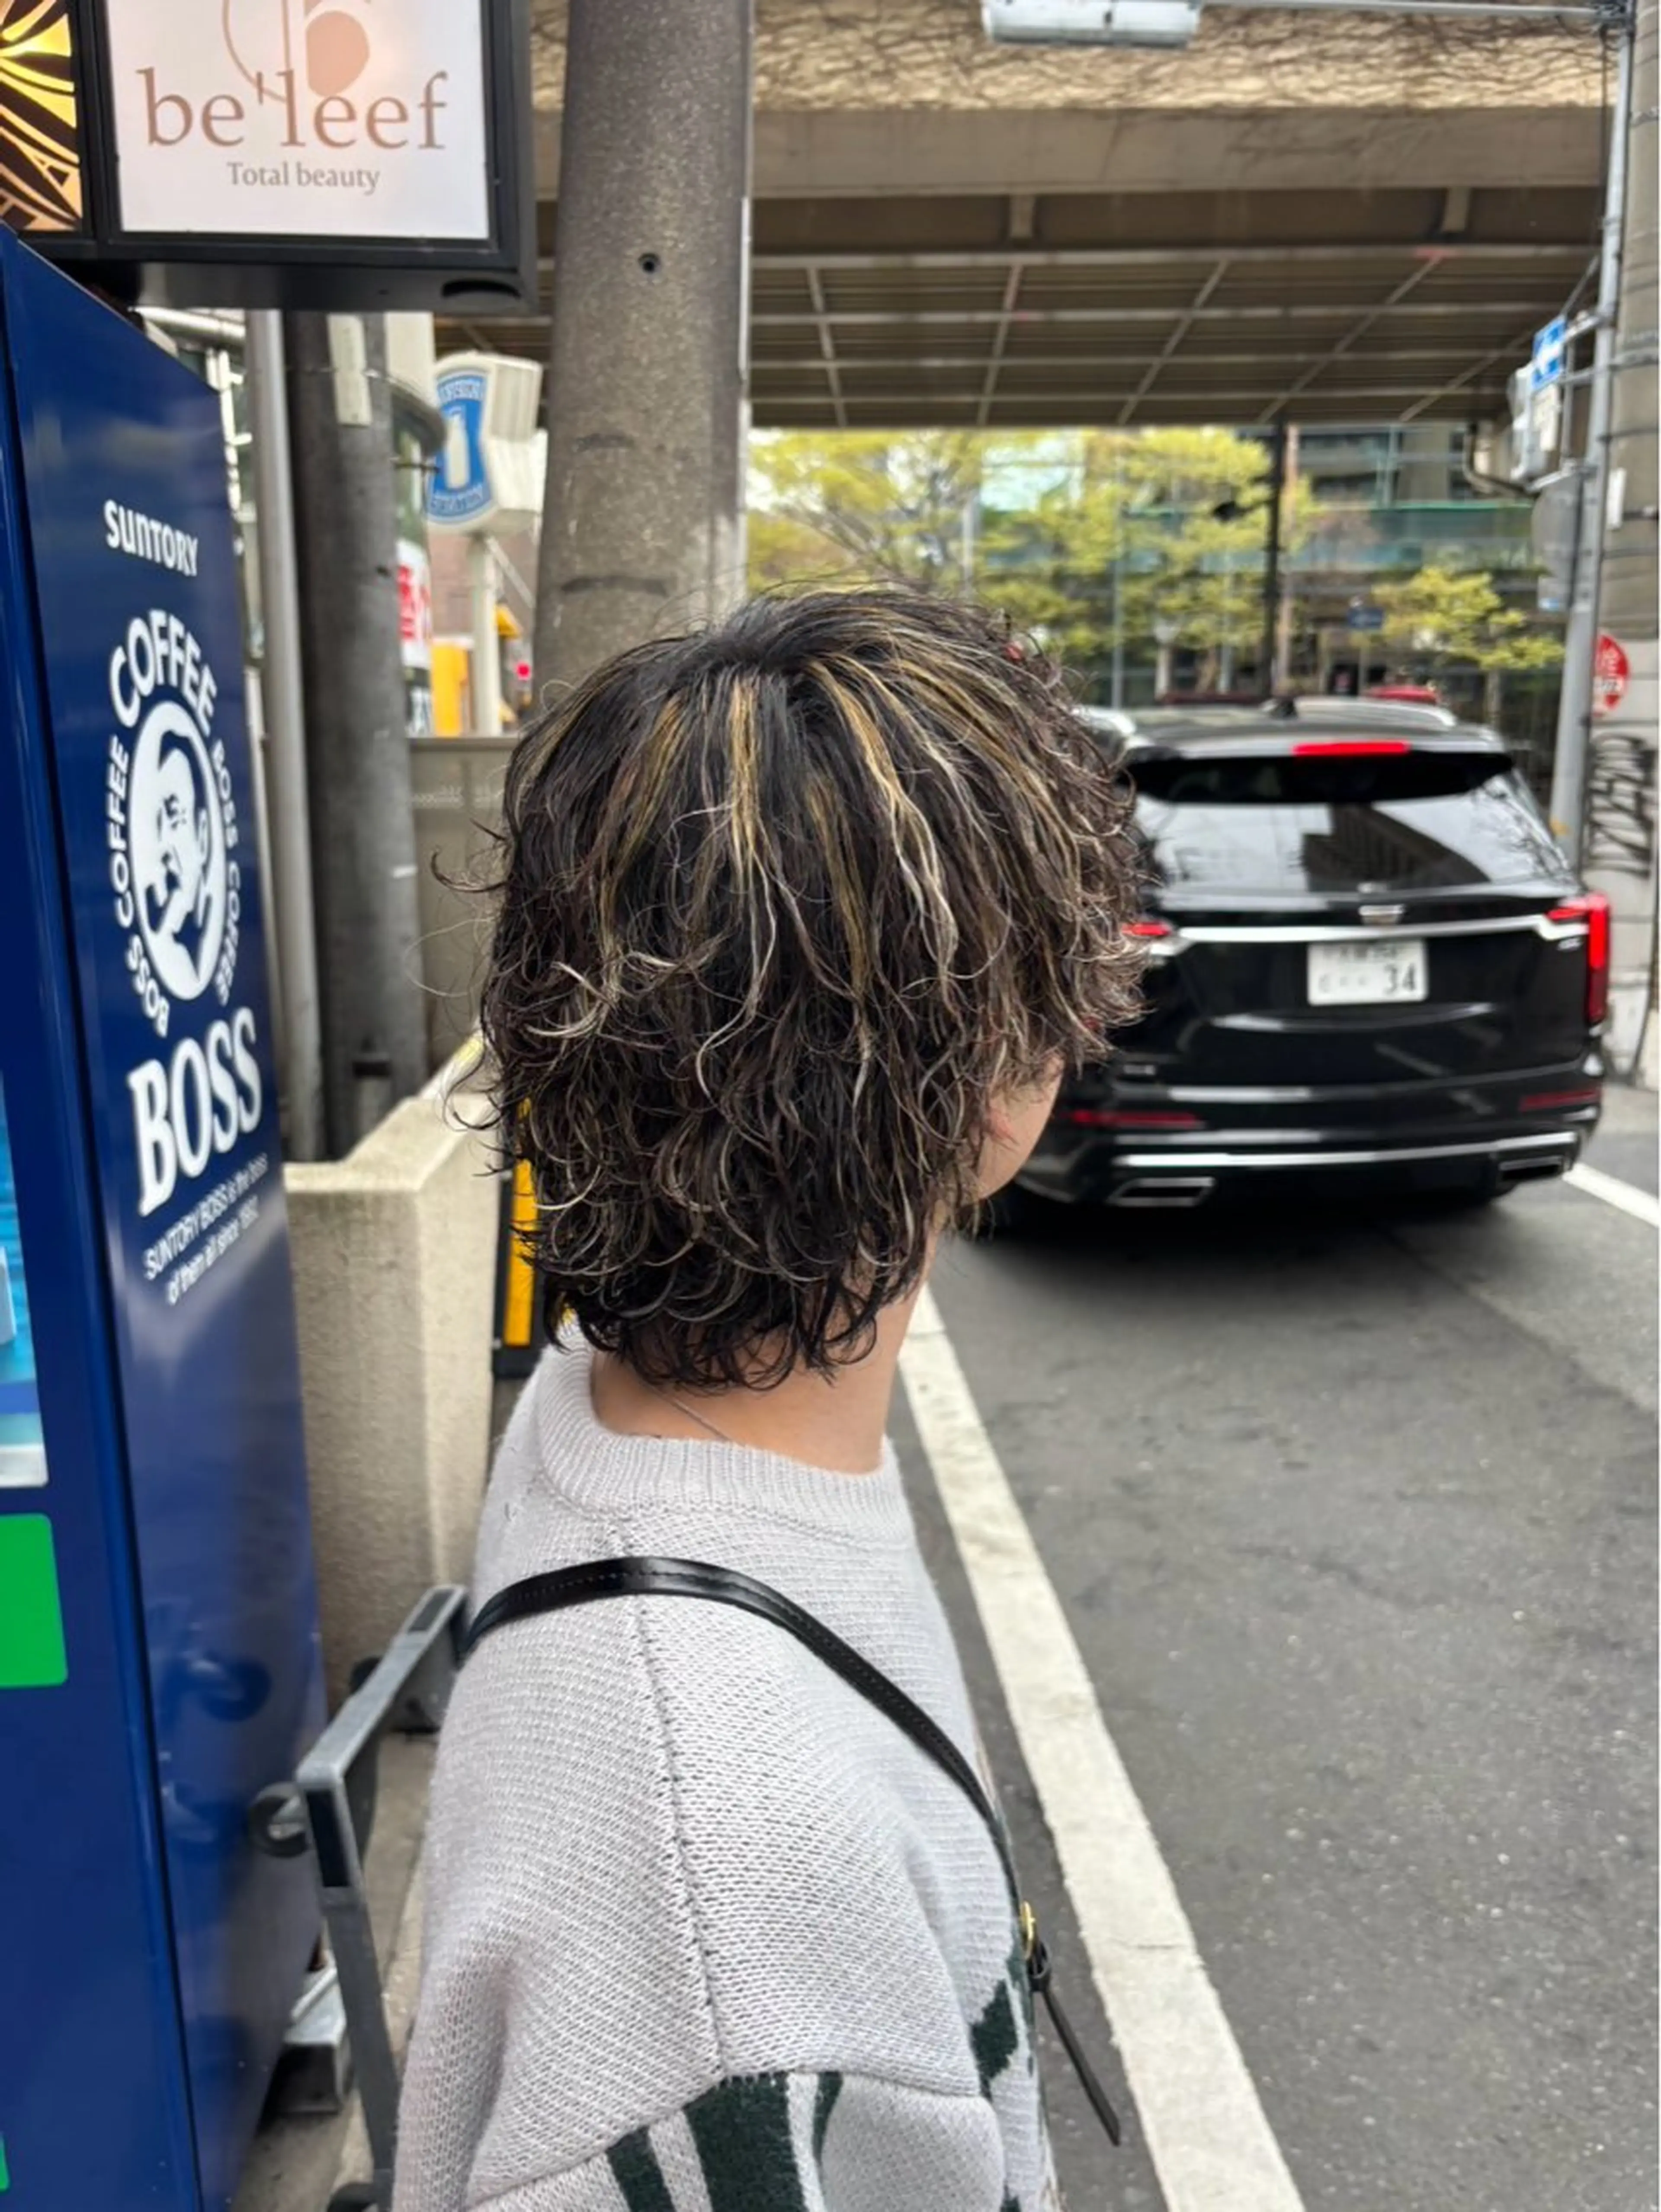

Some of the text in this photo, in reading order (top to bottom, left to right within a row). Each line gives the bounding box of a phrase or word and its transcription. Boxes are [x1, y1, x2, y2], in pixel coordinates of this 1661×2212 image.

[226, 162, 380, 196] Total beauty
[103, 499, 198, 577] SUNTORY
[109, 608, 218, 736] COFFEE
[106, 734, 134, 929] COFFEE
[125, 934, 170, 1038] BOSS
[128, 1006, 262, 1217] BOSS
